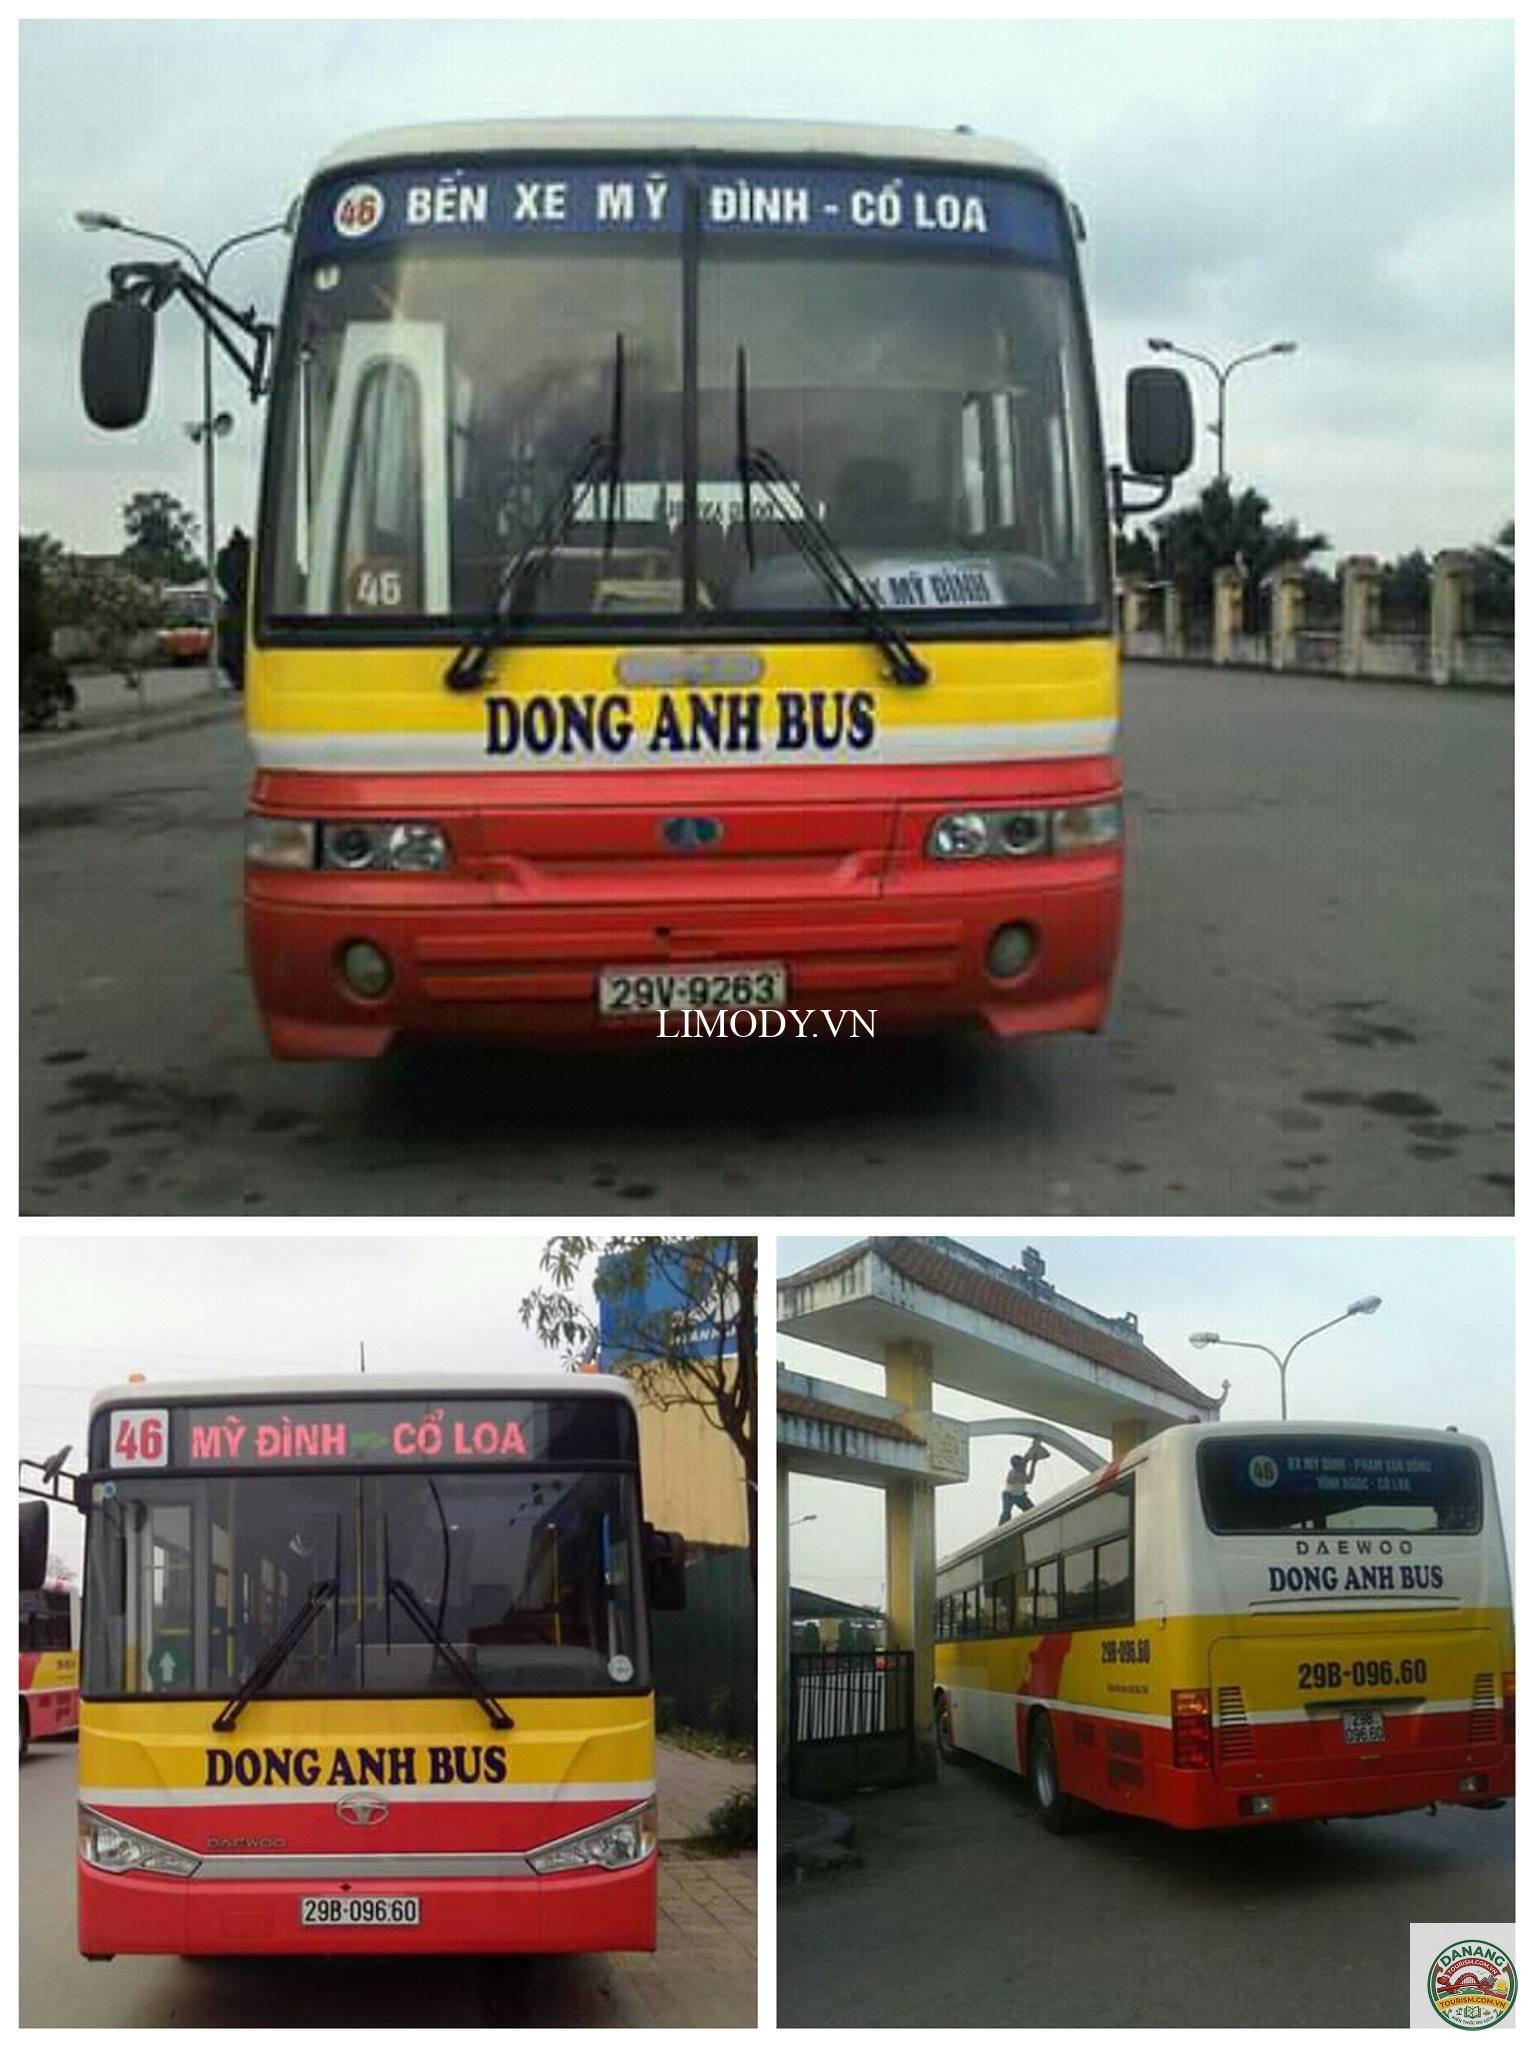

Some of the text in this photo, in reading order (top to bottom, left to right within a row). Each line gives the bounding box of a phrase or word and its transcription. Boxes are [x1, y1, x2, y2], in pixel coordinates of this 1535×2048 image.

[340, 194, 377, 226] 46
[406, 168, 489, 225] BẾN
[514, 182, 567, 221] XE
[597, 172, 669, 221] MỸ
[711, 178, 810, 223] ĐÌNH
[823, 204, 839, 214] -
[915, 192, 988, 232] LOA
[357, 571, 402, 606] 46
[486, 691, 876, 756] DONG ANH BUS
[115, 1418, 163, 1461] 46
[191, 1408, 528, 1459] MỸ ĐÌNH CỔ LOA
[1253, 1460, 1274, 1482] 46
[1296, 1540, 1413, 1555] DAEWOO
[1269, 1564, 1444, 1593] DONG ANH BUS
[1298, 1658, 1428, 1690] 29B-096.60
[205, 1745, 508, 1787] DONG ANH BUS
[304, 1899, 417, 1922] 29B-096.60
